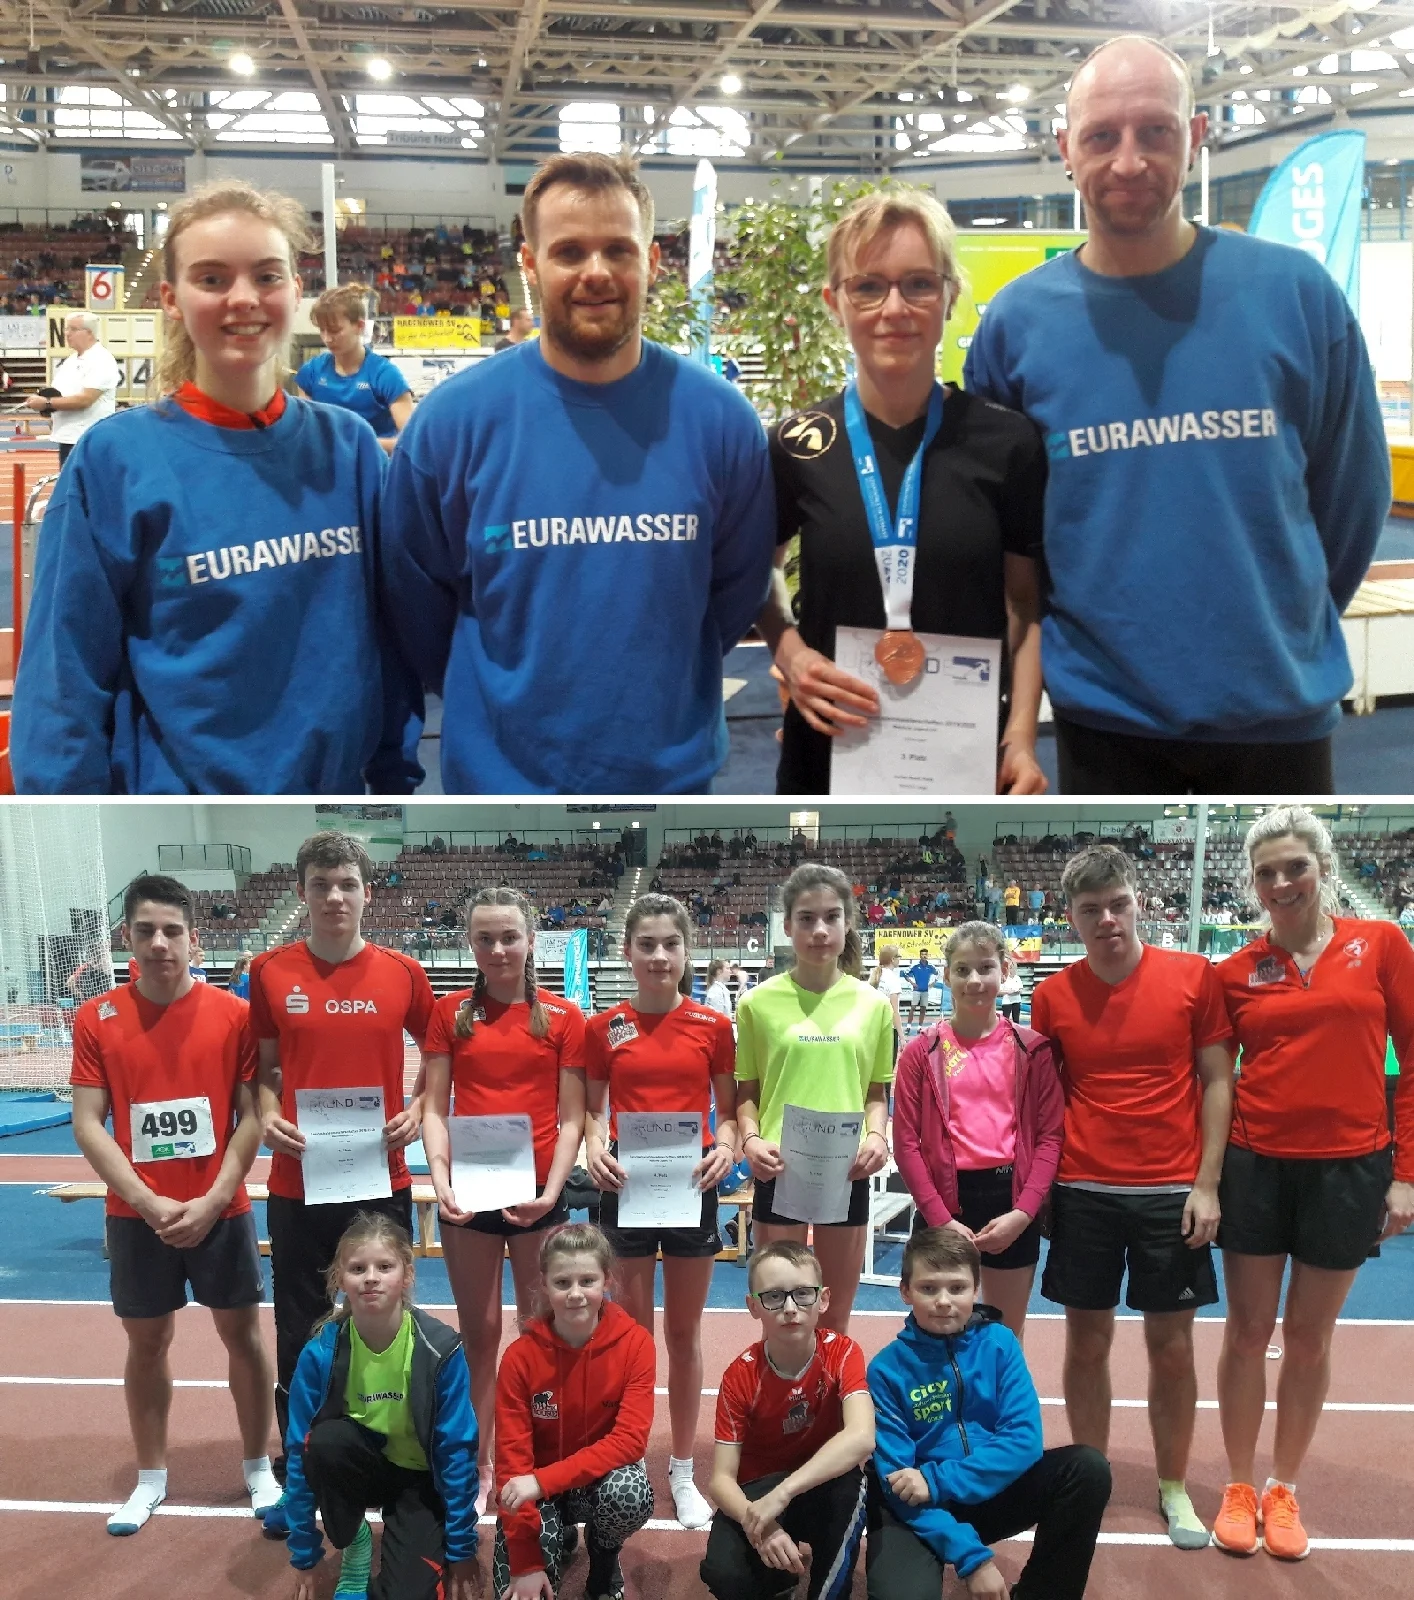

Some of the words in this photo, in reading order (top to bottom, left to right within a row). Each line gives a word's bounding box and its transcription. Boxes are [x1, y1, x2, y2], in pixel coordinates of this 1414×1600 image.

[92, 271, 112, 300] 6
[1068, 408, 1278, 458] EURAWASSER
[511, 513, 700, 549] EURAWASSER
[747, 937, 759, 953] C
[1161, 932, 1174, 947] B
[325, 1000, 378, 1014] OSPA
[141, 1109, 198, 1138] 499
[995, 1165, 1013, 1175] NIK
